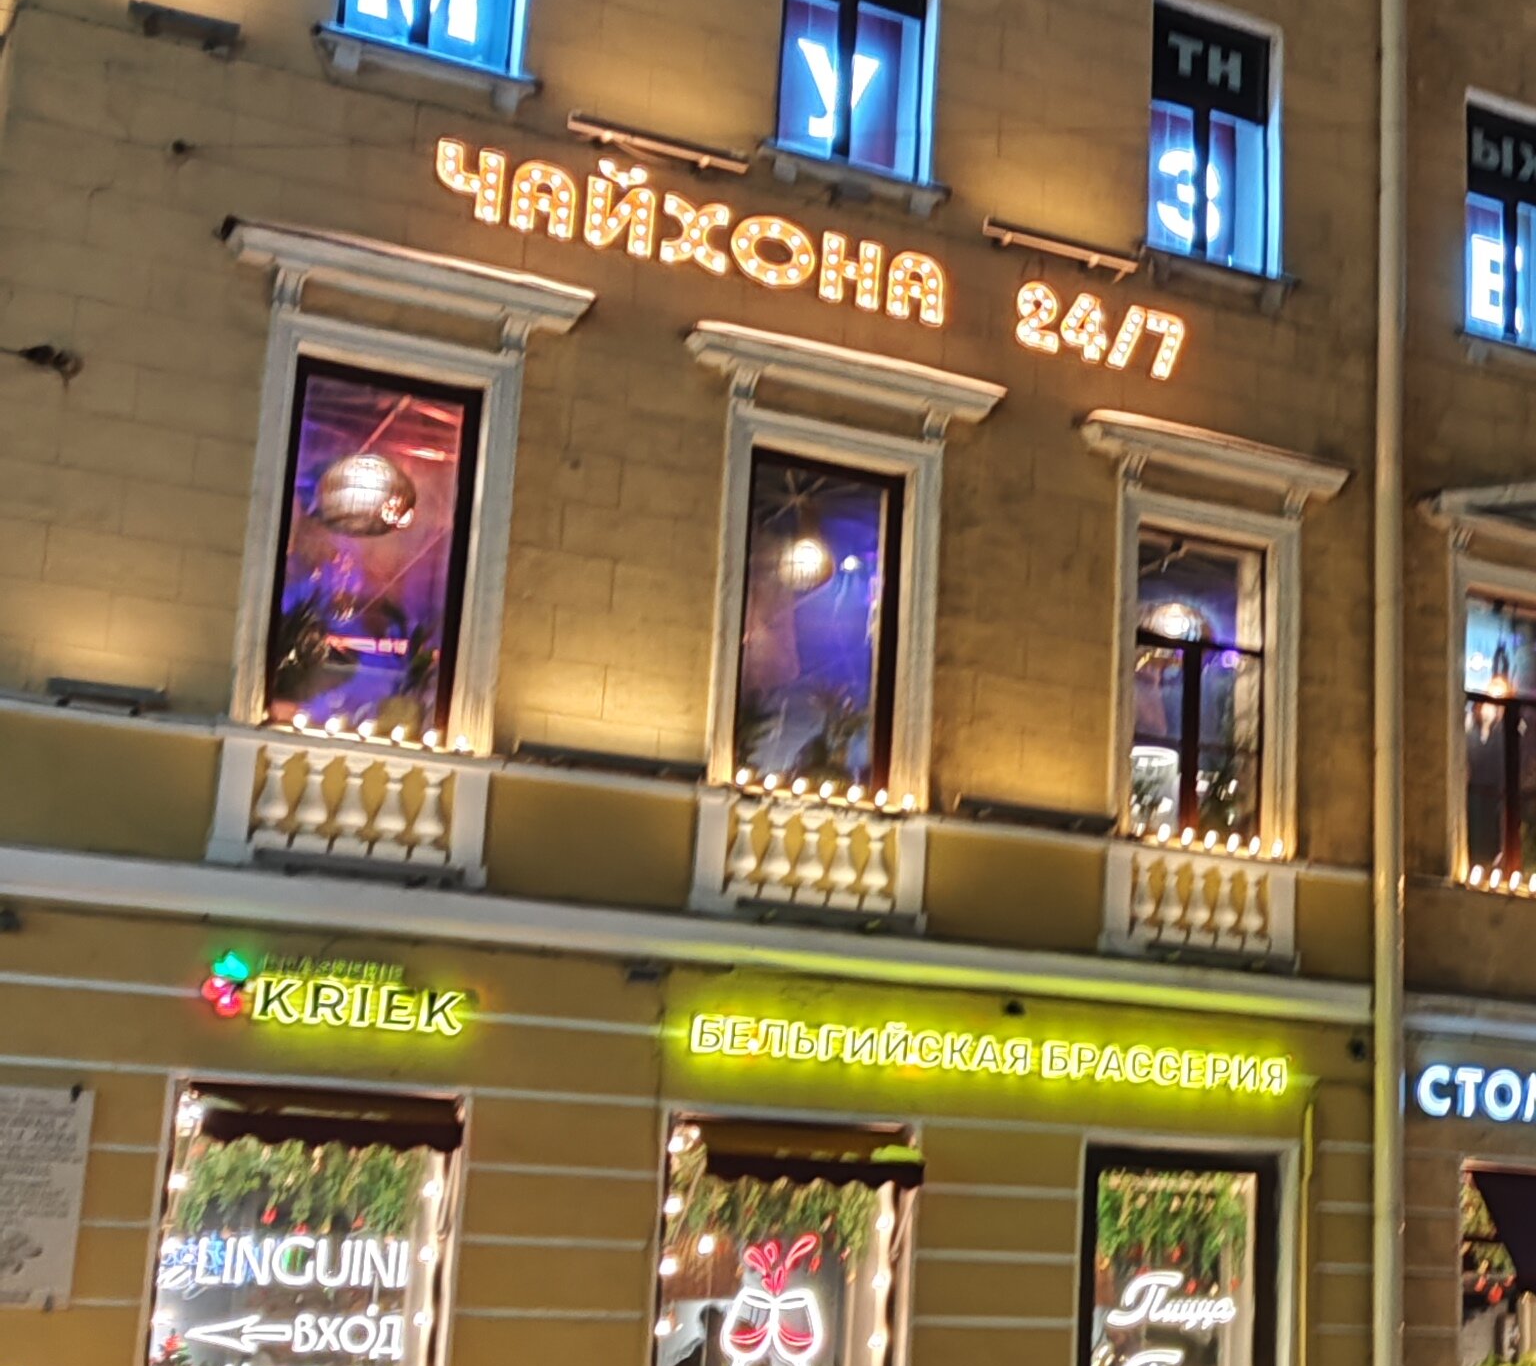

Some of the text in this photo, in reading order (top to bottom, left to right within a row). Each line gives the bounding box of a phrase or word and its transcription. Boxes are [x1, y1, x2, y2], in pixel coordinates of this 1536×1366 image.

[434, 136, 1186, 380] ЧАЙХОНА 24/7
[251, 976, 465, 1036] KRIEK
[690, 1013, 1289, 1096] БЕЛЬГИЙСКАЯ БРАССЕРИЯ
[195, 1235, 410, 1288] LINGUINI
[1107, 1271, 1236, 1329] Пицца
[291, 1314, 405, 1359] ВХОД
